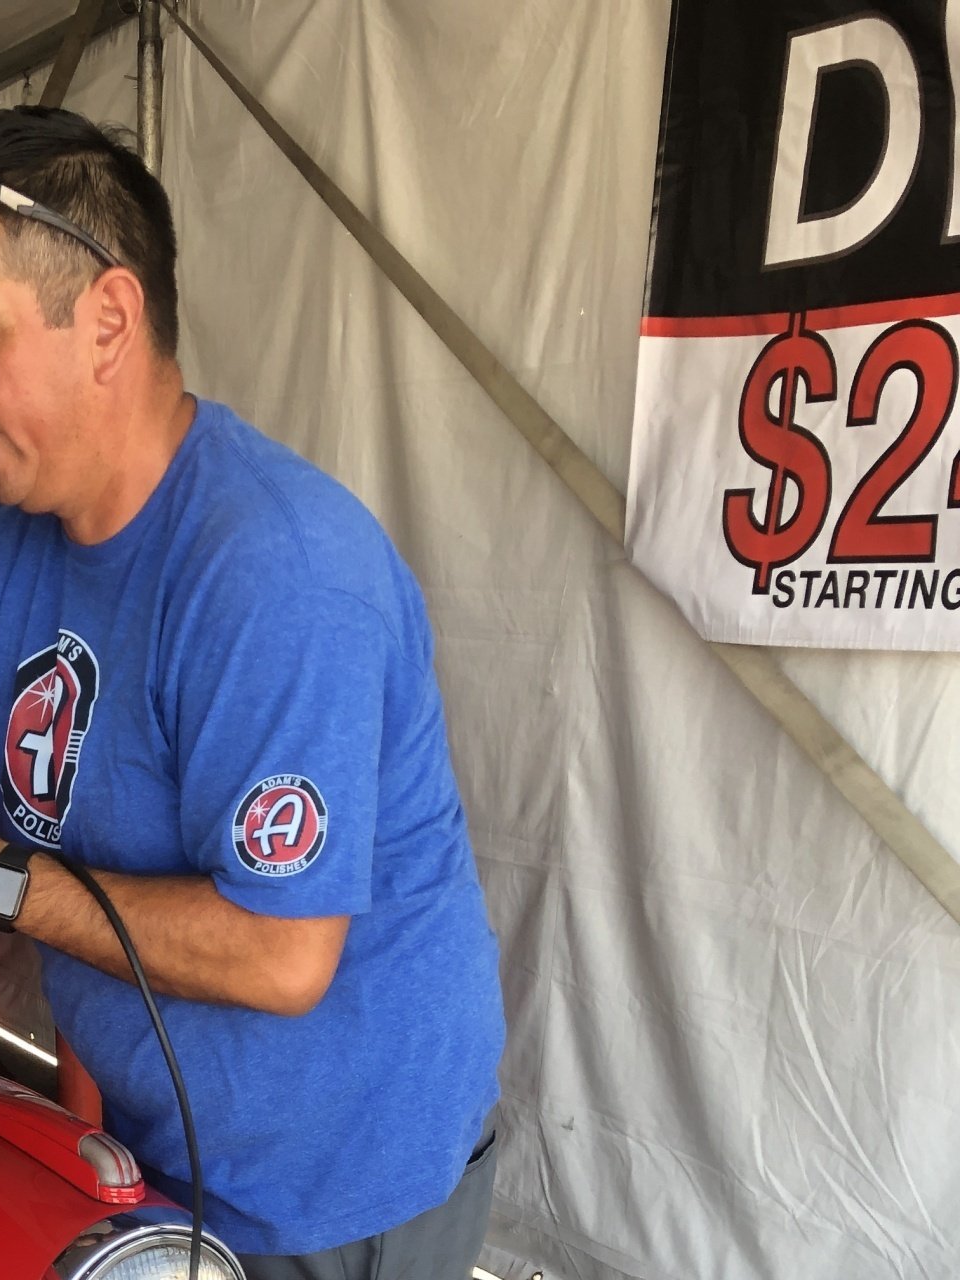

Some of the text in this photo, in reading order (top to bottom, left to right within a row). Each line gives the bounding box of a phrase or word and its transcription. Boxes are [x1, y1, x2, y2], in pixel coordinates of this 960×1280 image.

[762, 0, 960, 271] D
[722, 312, 960, 594] $2
[772, 569, 960, 609] STARTING
[262, 776, 302, 791] ADAM'S
[252, 794, 303, 856] A
[254, 858, 307, 873] POLISHES
